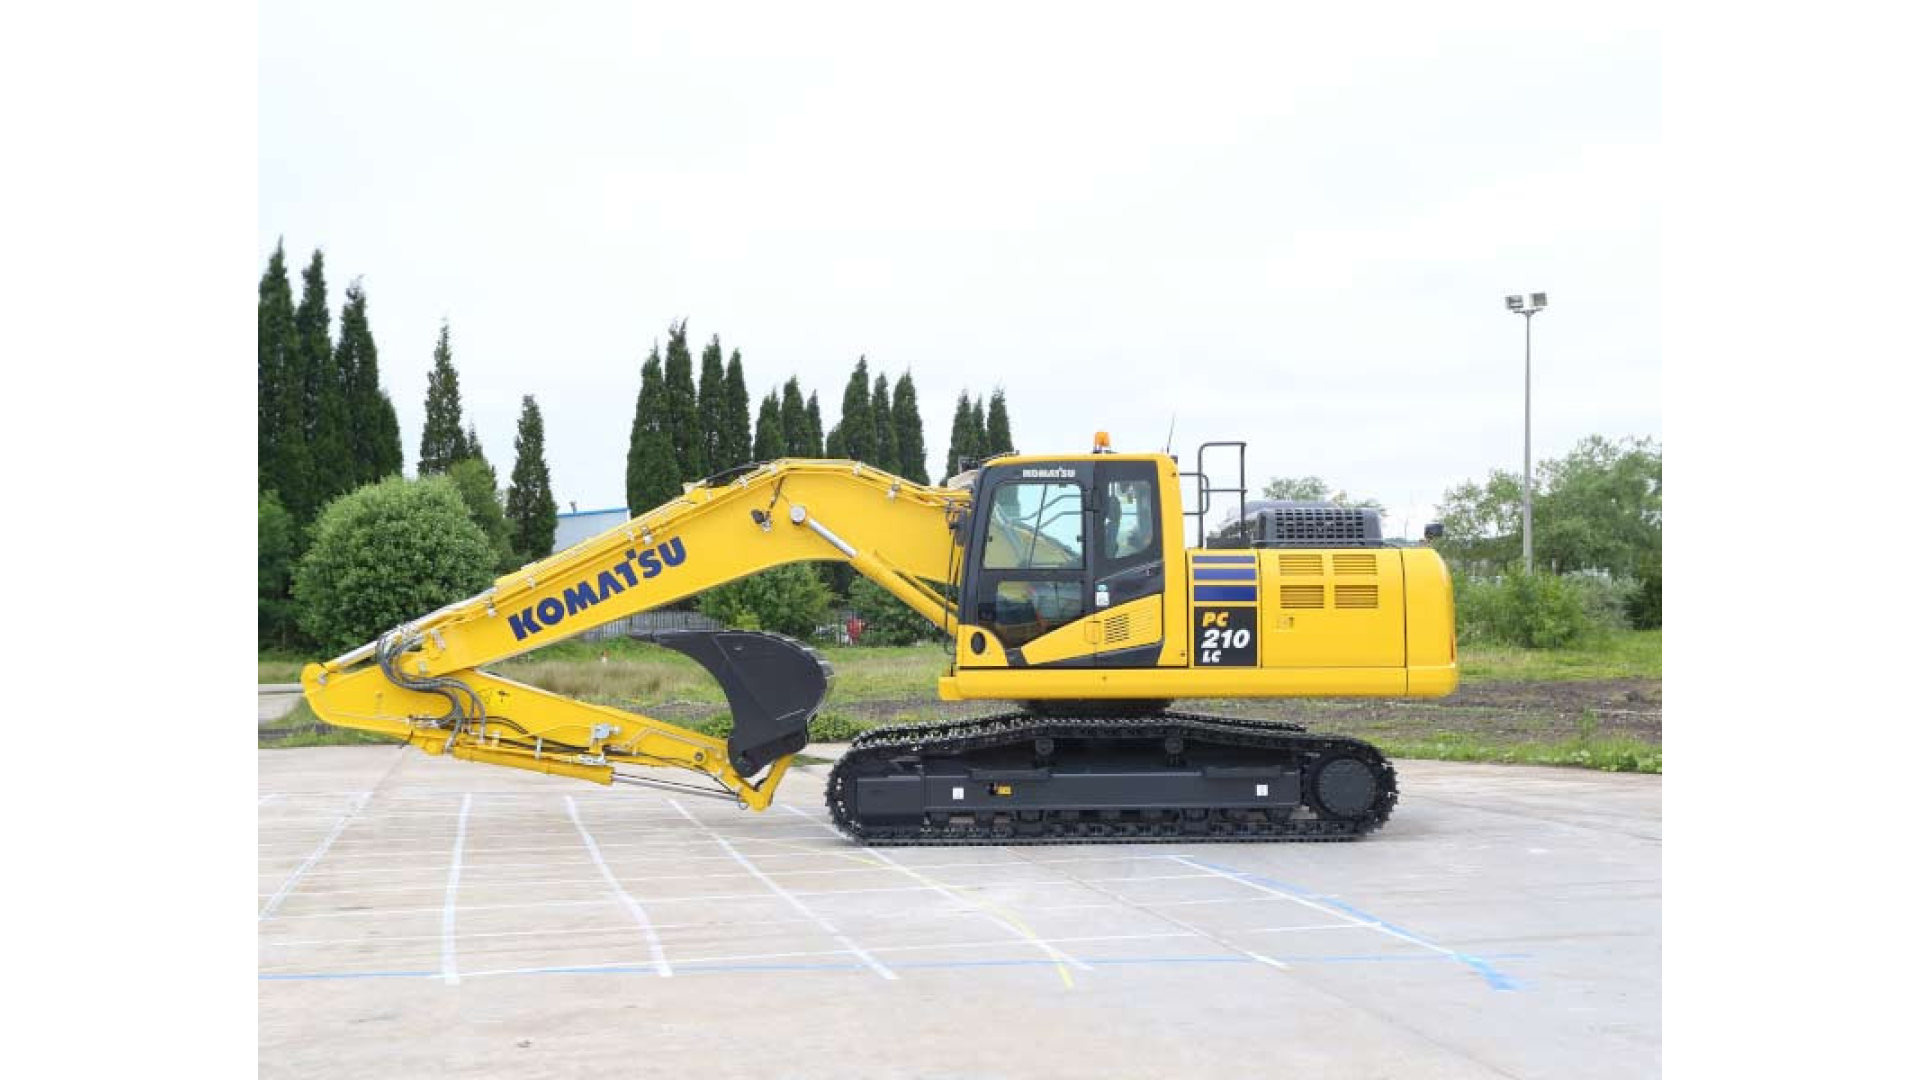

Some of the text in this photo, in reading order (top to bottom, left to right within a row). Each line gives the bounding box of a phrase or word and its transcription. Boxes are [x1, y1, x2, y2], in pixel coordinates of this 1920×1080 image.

[507, 536, 687, 641] KOMATSU
[1202, 611, 1229, 628] PC
[1201, 629, 1251, 649] 210
[1202, 650, 1222, 663] LC
